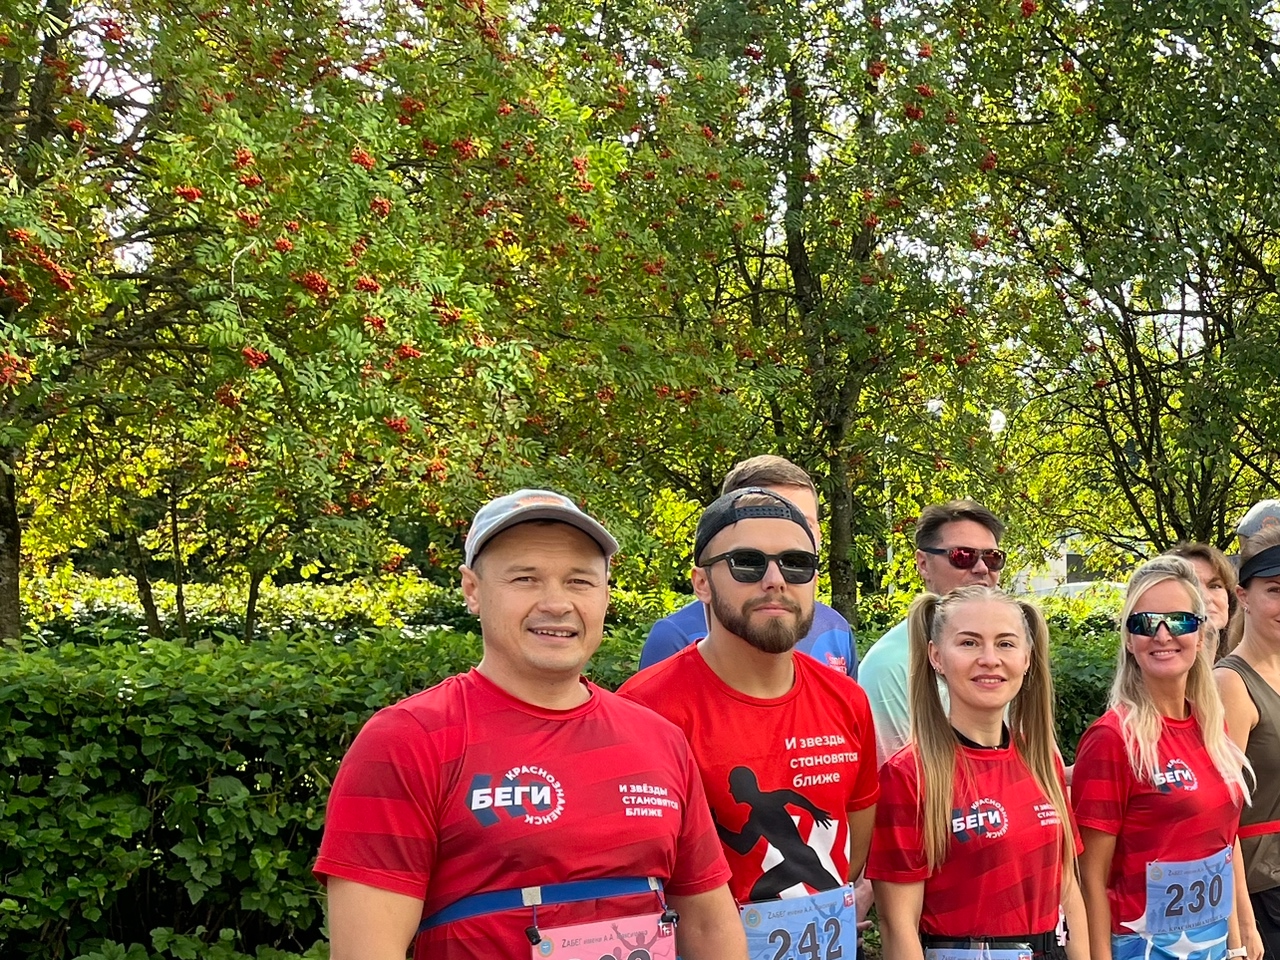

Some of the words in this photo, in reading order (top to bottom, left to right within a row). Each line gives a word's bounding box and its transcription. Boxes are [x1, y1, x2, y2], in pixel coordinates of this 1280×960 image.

[785, 737, 797, 750] И
[800, 735, 846, 749] звезды
[790, 752, 858, 769] становятся
[793, 772, 841, 788] ближе
[1154, 769, 1193, 787] БЕГИ
[505, 765, 566, 825] КРАСНОЗНАМЕНСК
[618, 784, 628, 793] И
[471, 785, 552, 811] БЕГИ
[625, 807, 663, 817] БЛИЖЕ
[951, 810, 1002, 833] БЕГИ
[1164, 873, 1224, 919] 230
